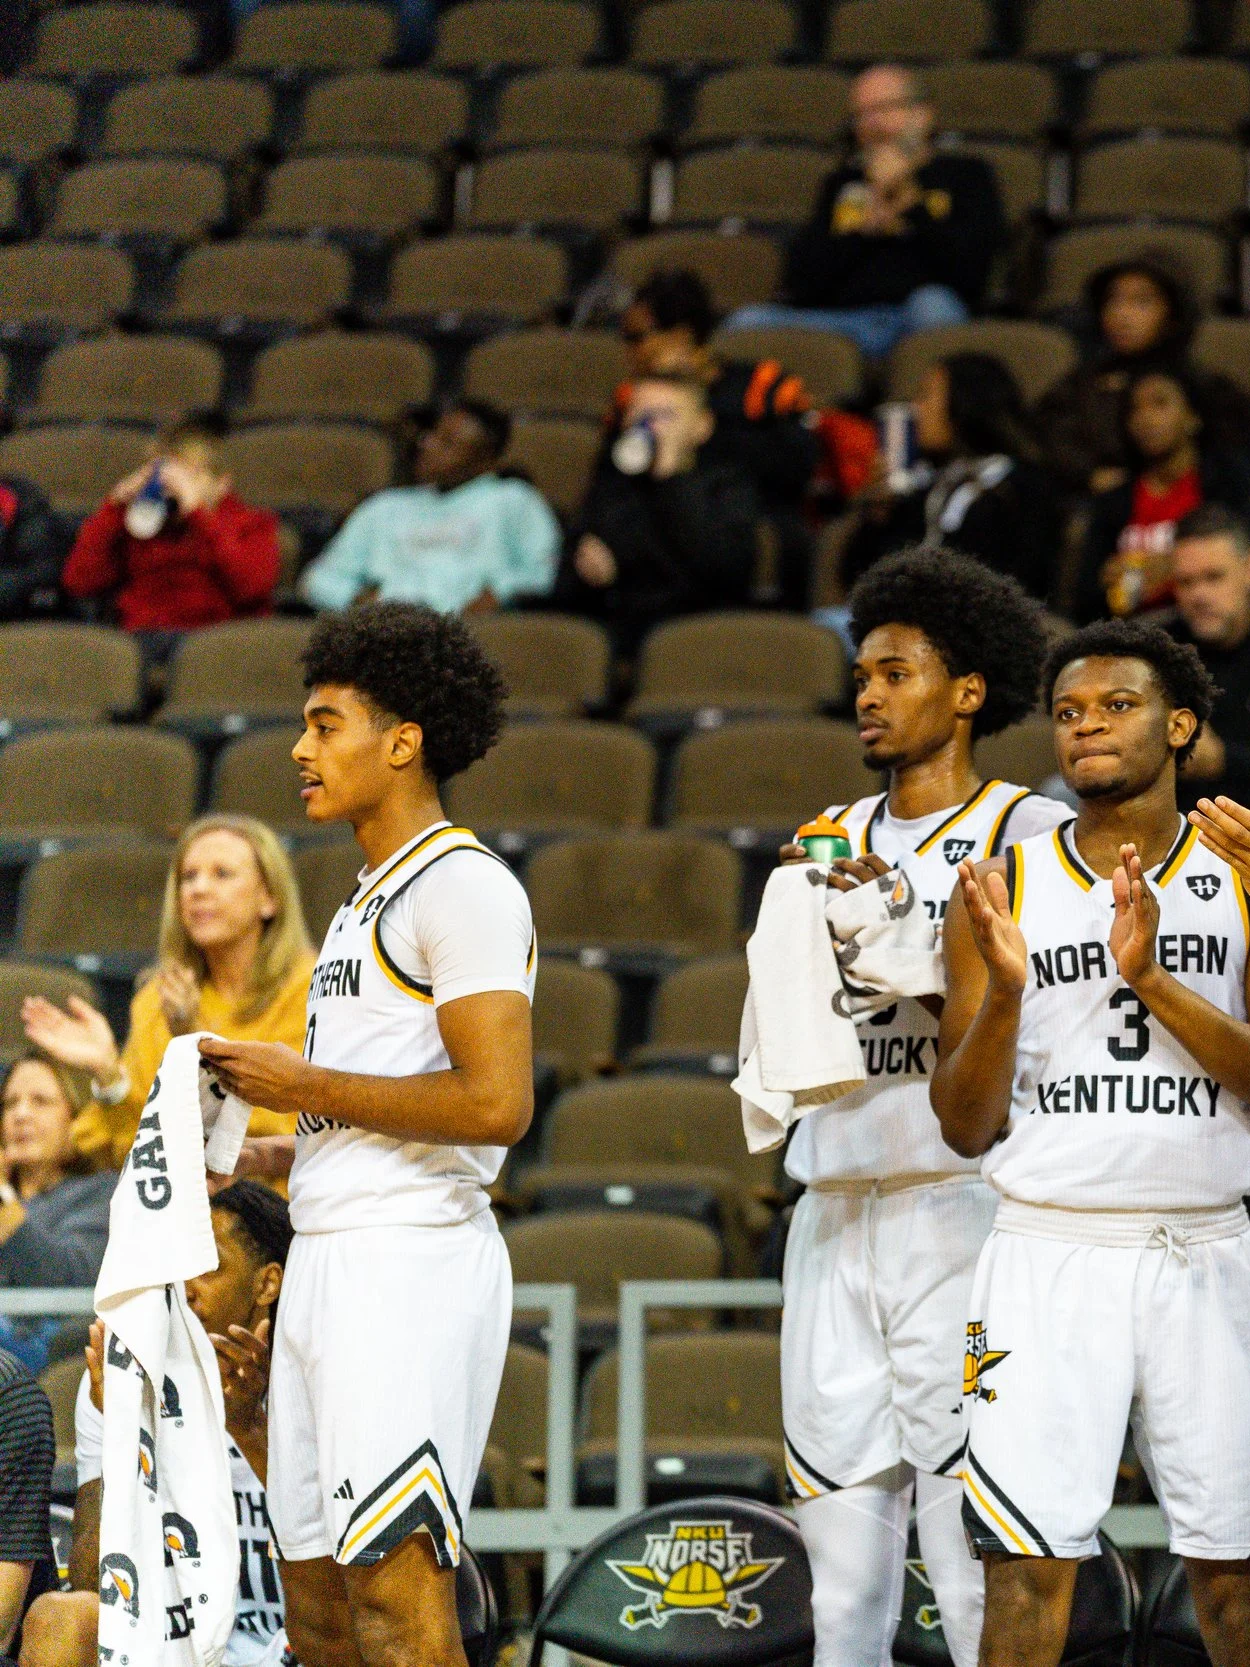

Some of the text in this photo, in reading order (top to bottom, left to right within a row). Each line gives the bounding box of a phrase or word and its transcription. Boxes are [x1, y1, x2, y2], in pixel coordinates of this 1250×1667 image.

[1030, 934, 1228, 989] NORERN
[1107, 988, 1150, 1061] 3
[1030, 1075, 1221, 1117] KENTUCKY
[676, 1526, 725, 1540] NKU
